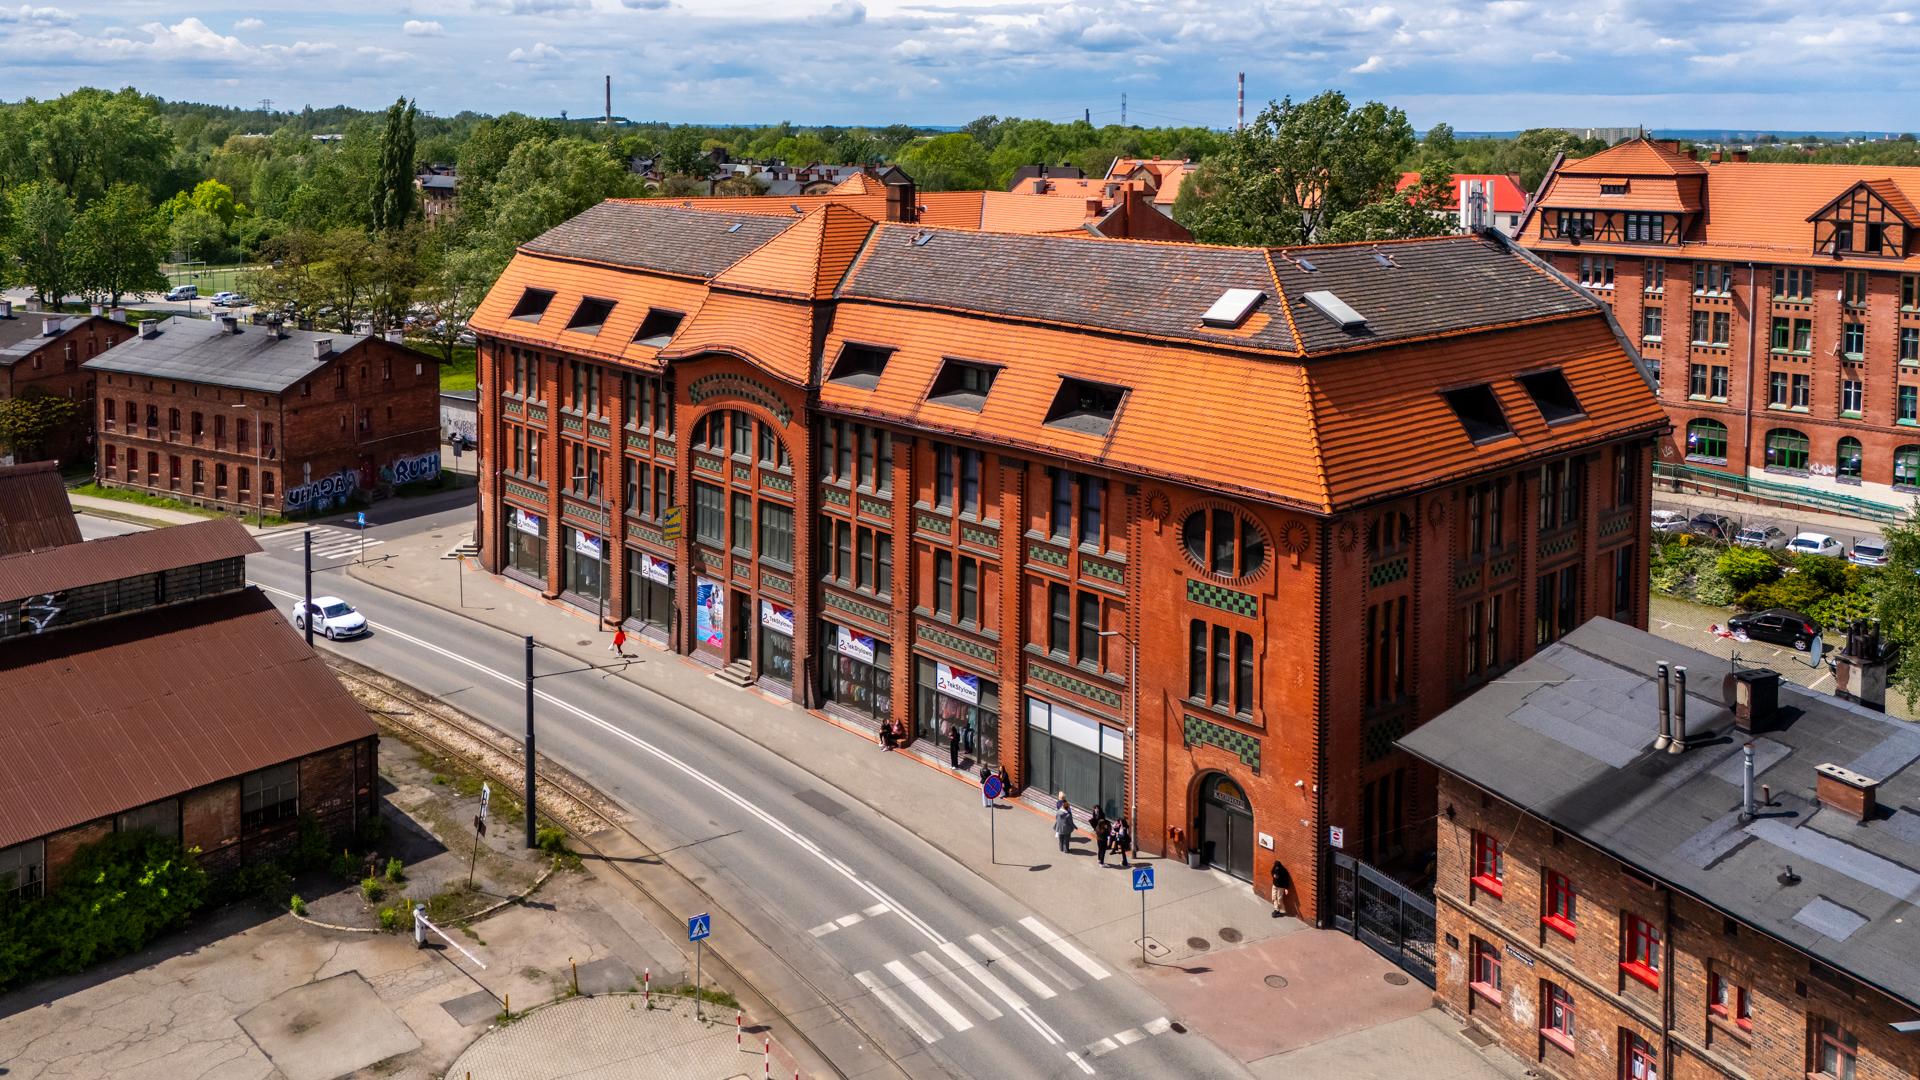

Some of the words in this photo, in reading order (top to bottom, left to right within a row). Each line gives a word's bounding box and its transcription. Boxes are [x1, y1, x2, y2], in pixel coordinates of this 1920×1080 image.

[394, 454, 438, 483] RUCH
[847, 642, 872, 656] TekStylowo
[947, 680, 976, 697] TekStylowo
